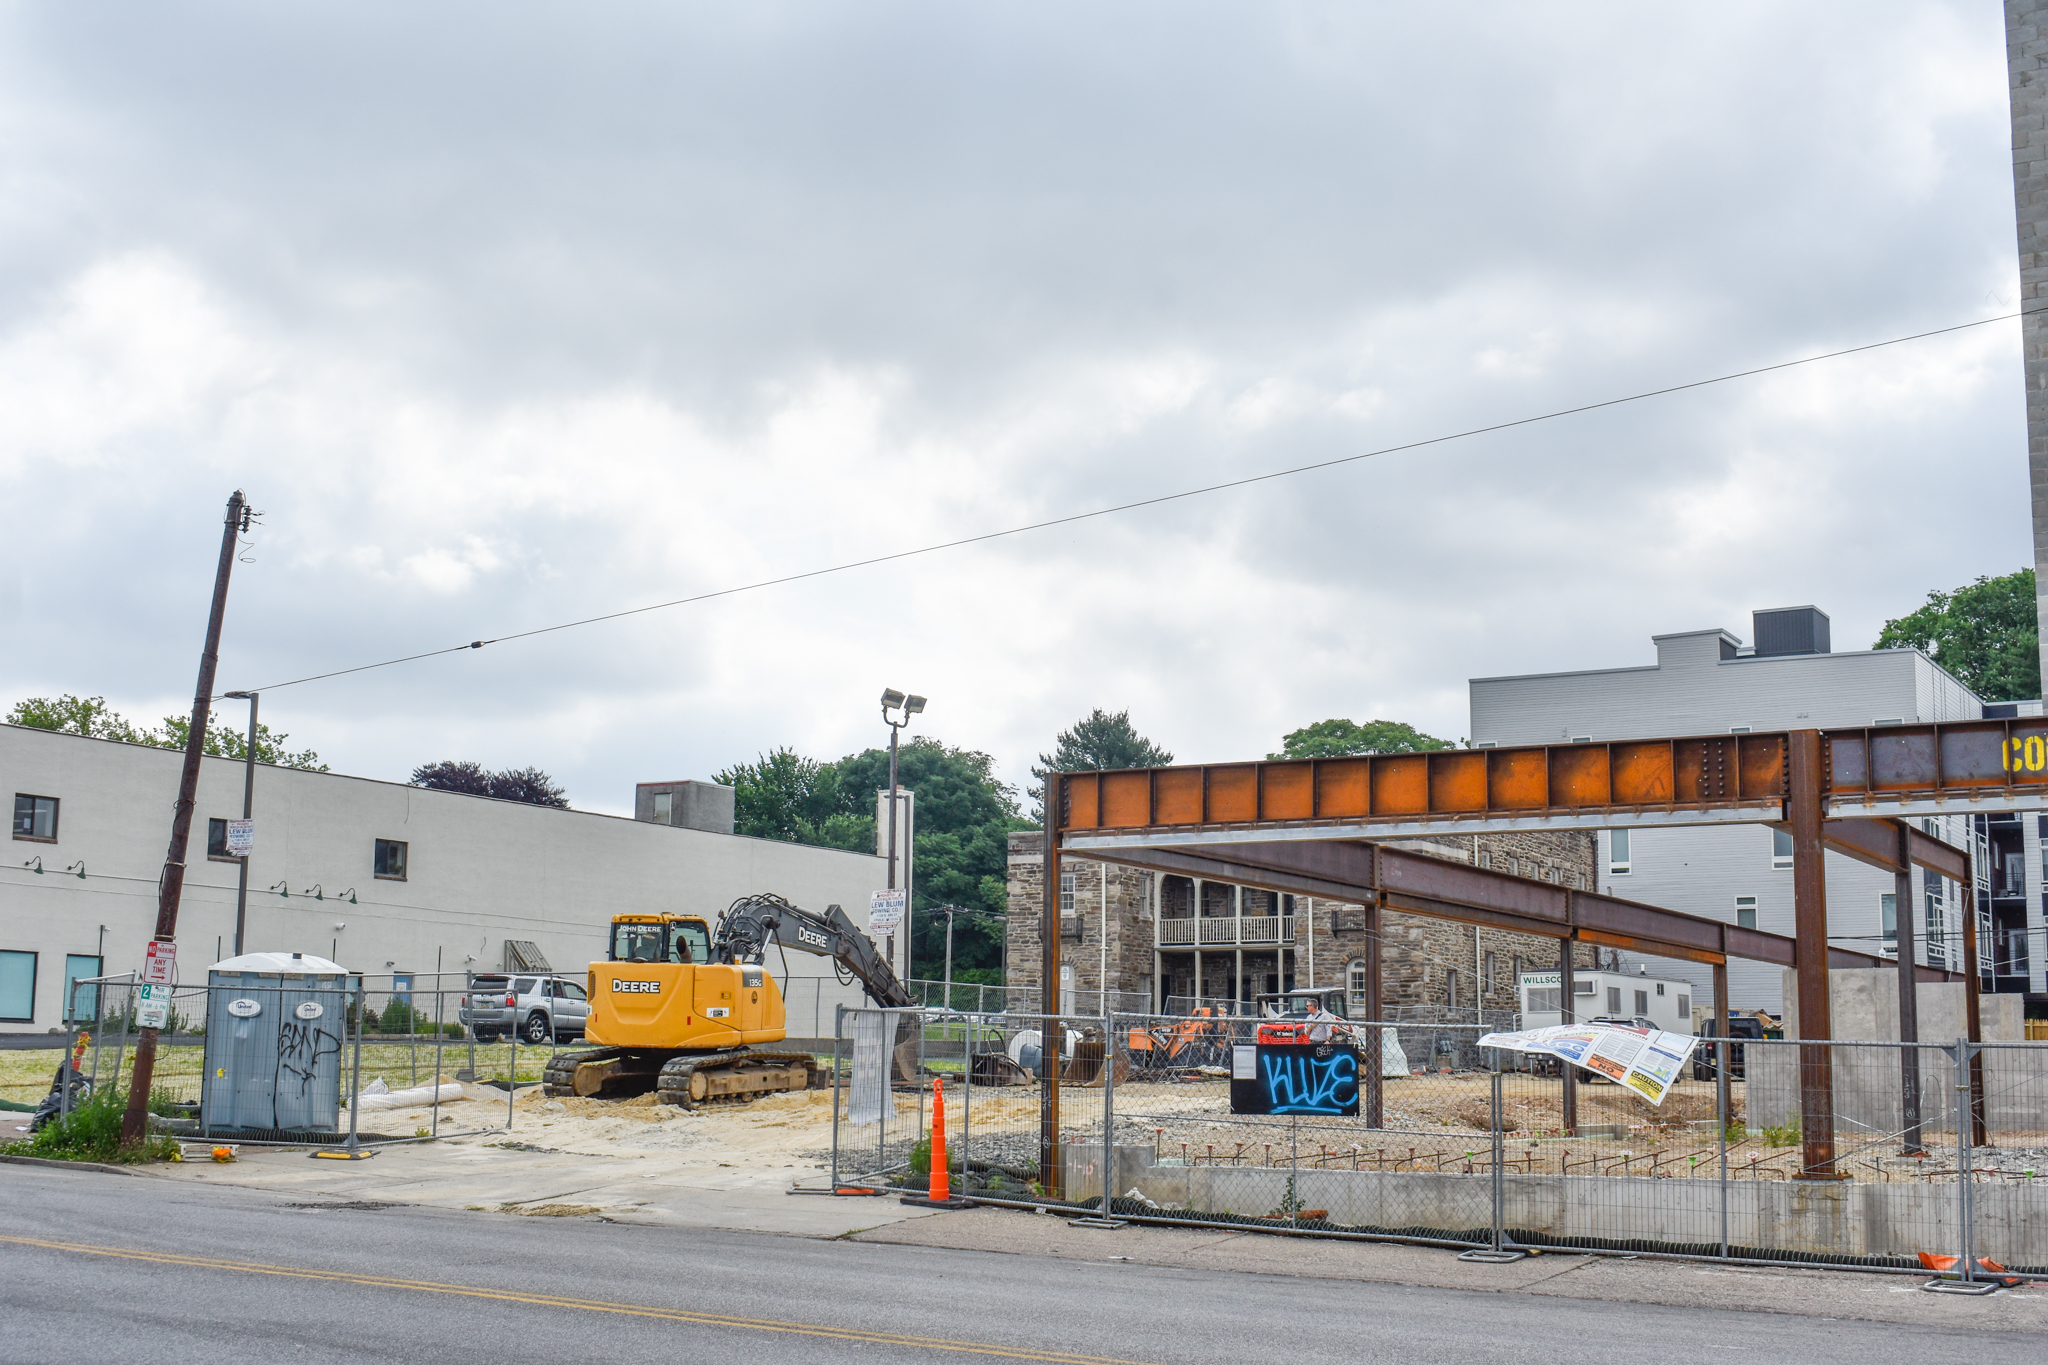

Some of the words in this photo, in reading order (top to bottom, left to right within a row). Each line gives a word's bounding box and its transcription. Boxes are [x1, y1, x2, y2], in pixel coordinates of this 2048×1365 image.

[2002, 735, 2048, 772] CO
[798, 926, 828, 948] DEERE
[148, 945, 156, 954] NO
[154, 958, 167, 966] ANY
[152, 966, 166, 974] TIME
[612, 978, 660, 993] DEERE
[750, 978, 762, 986] 135G
[142, 986, 150, 998] 2
[150, 992, 169, 1000] PARKING
[1598, 1064, 1614, 1072] NO
[1632, 1072, 1662, 1092] CAUTION
